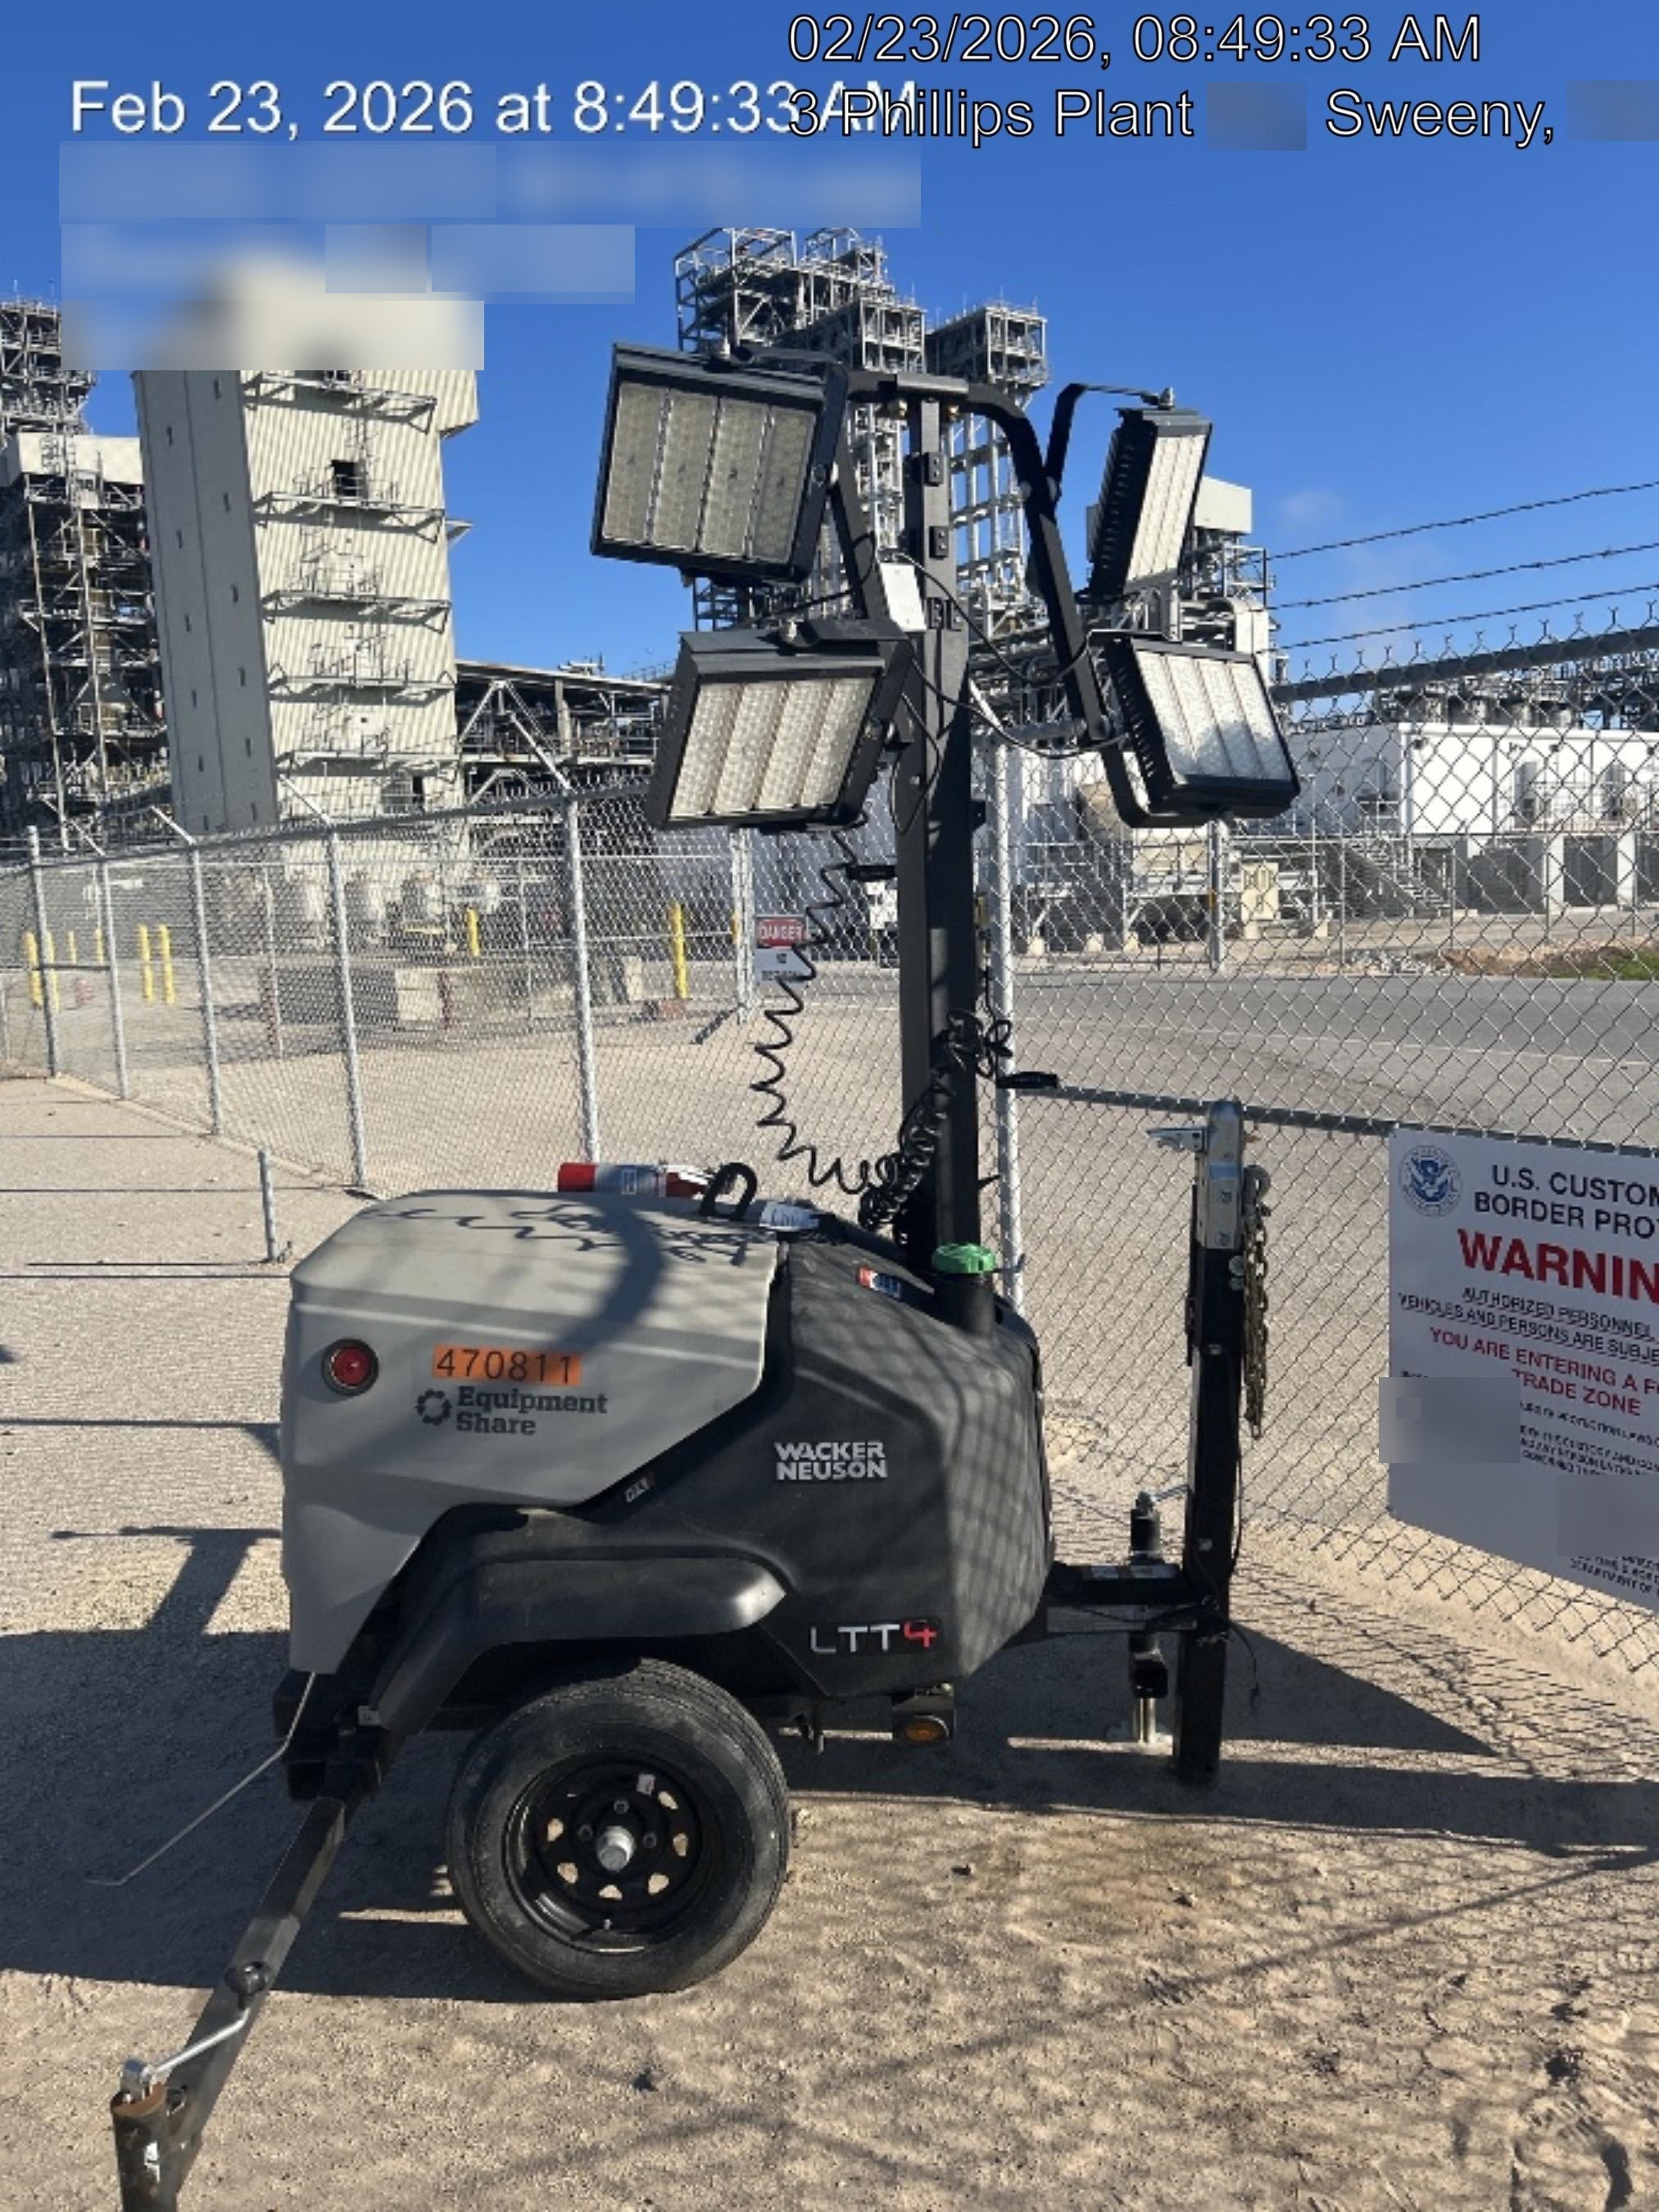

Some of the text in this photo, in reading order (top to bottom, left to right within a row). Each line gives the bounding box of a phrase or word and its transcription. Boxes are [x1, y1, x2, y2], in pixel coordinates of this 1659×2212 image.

[1492, 1164, 1540, 1190] U.S.
[1475, 1191, 1659, 1240] BORDER PRO
[1457, 1228, 1659, 1307] WARNIN
[1398, 1292, 1463, 1319] VEHICLES
[1467, 1307, 1496, 1326] AND
[1500, 1314, 1569, 1344] PERSONS
[1573, 1331, 1604, 1351] ARE
[1462, 1287, 1651, 1339] AUTHORIZED PERSONNEL
[436, 1349, 571, 1384] 470811
[1430, 1327, 1469, 1350] YOU
[1473, 1339, 1511, 1360] ARE
[1516, 1348, 1616, 1387] ENTERING
[1621, 1373, 1638, 1392] A
[456, 1385, 608, 1414] Equipment
[1512, 1368, 1641, 1416] TRADE ZONE
[456, 1410, 537, 1435] Share
[774, 1441, 886, 1462] WACKER
[776, 1459, 888, 1481] NEUSON
[810, 1621, 937, 1654] LTT4
